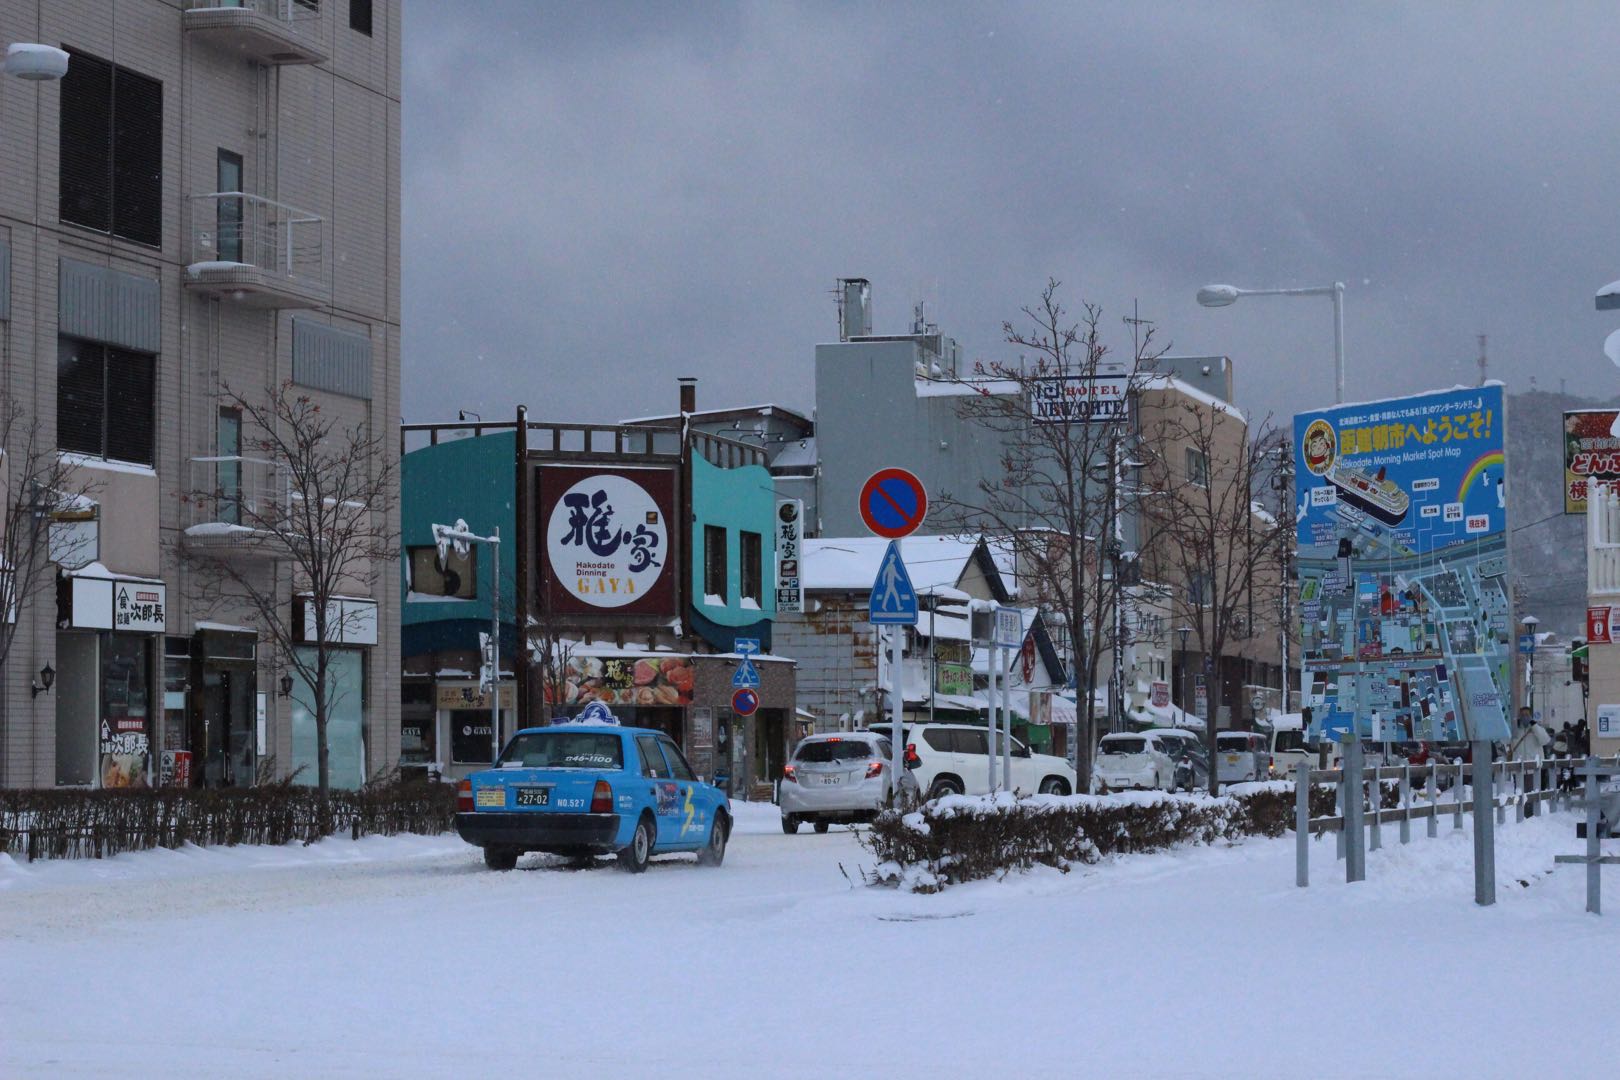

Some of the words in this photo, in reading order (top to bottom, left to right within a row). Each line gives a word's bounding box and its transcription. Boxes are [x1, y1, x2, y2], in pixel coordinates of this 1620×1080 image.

[1066, 385, 1120, 396] HOTEL
[1340, 409, 1493, 455] 函館朝市へようこそ!
[1340, 457, 1372, 470] Hakodate
[1373, 454, 1401, 466] Morning
[1402, 450, 1427, 462] Market
[1428, 449, 1444, 461] Spot
[1445, 447, 1462, 459] Map
[1468, 519, 1487, 528] 現在地
[560, 489, 662, 573] 雅家
[576, 561, 615, 570] Hakodate
[576, 569, 607, 578] Dinning
[577, 577, 635, 595] GAYA
[790, 579, 799, 588] P
[131, 602, 164, 623] 次郎長
[402, 727, 421, 736] GAYA
[473, 727, 492, 736] GAYA
[111, 733, 149, 755] 次郎長
[571, 754, 613, 763] 46-1100
[523, 794, 548, 805] 27-02
[557, 798, 585, 808] NO.527
